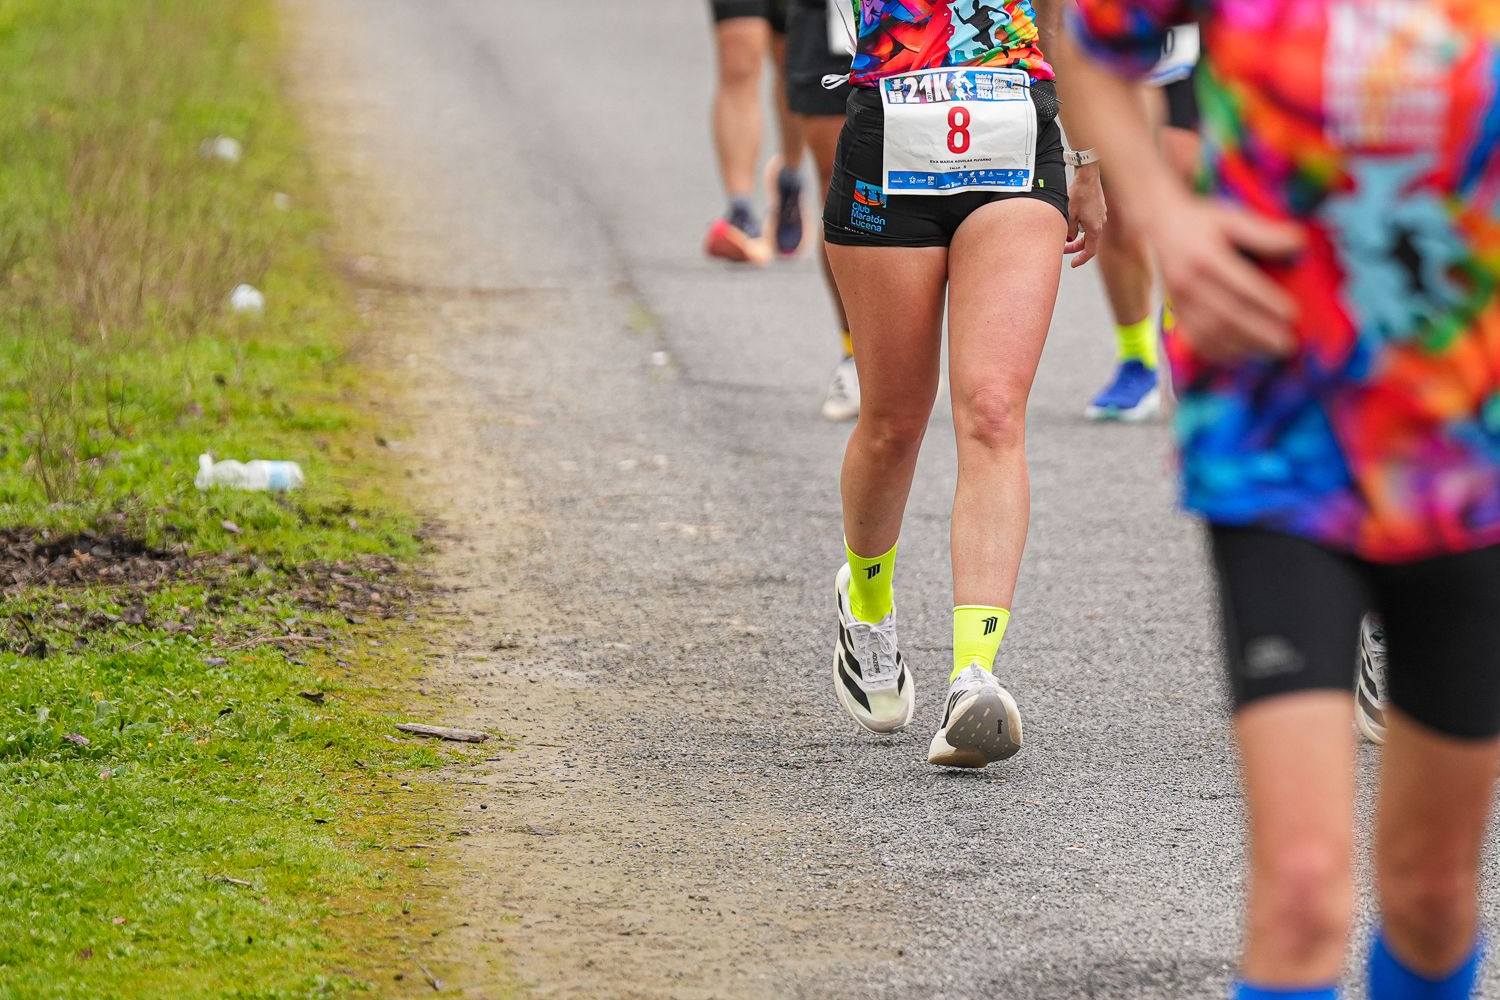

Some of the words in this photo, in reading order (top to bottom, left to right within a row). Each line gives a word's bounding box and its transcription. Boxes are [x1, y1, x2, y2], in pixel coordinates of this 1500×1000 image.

[904, 73, 951, 102] 21K
[947, 106, 970, 154] 8
[852, 202, 870, 213] Club
[850, 217, 882, 232] Lucena
[851, 209, 885, 225] Maratón
